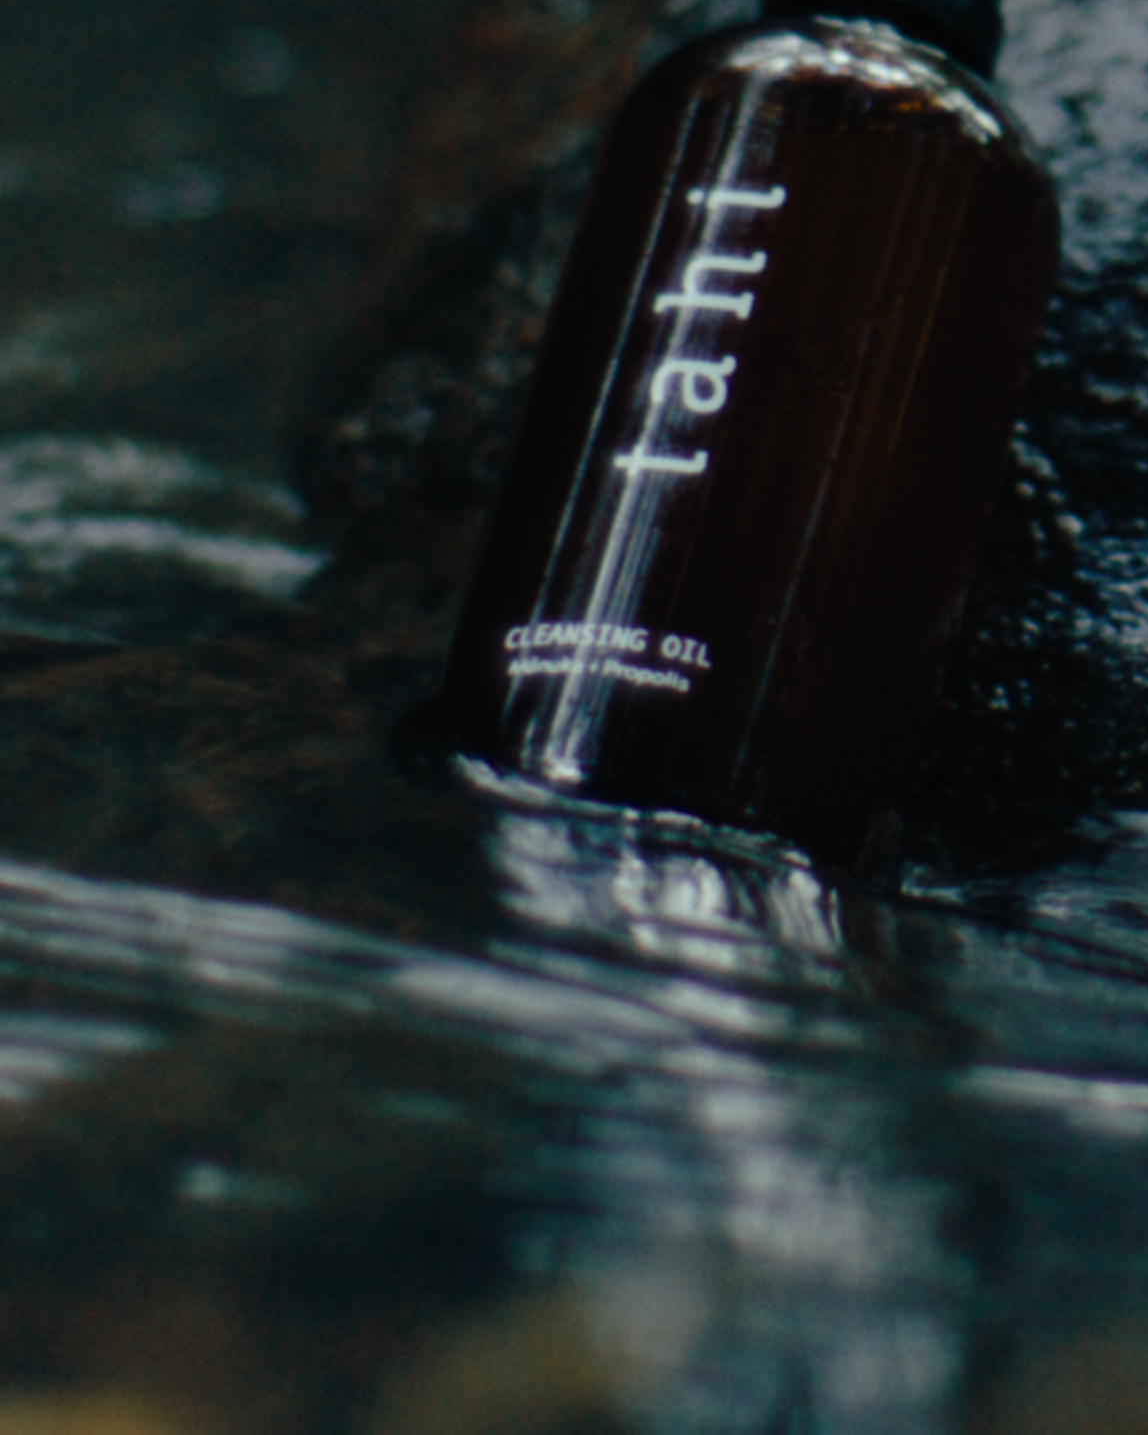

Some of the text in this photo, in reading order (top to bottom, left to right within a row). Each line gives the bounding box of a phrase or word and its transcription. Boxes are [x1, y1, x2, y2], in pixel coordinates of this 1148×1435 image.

[612, 184, 787, 477] tahi
[504, 622, 712, 669] CLEANSING OIL
[602, 659, 690, 692] Propolis
